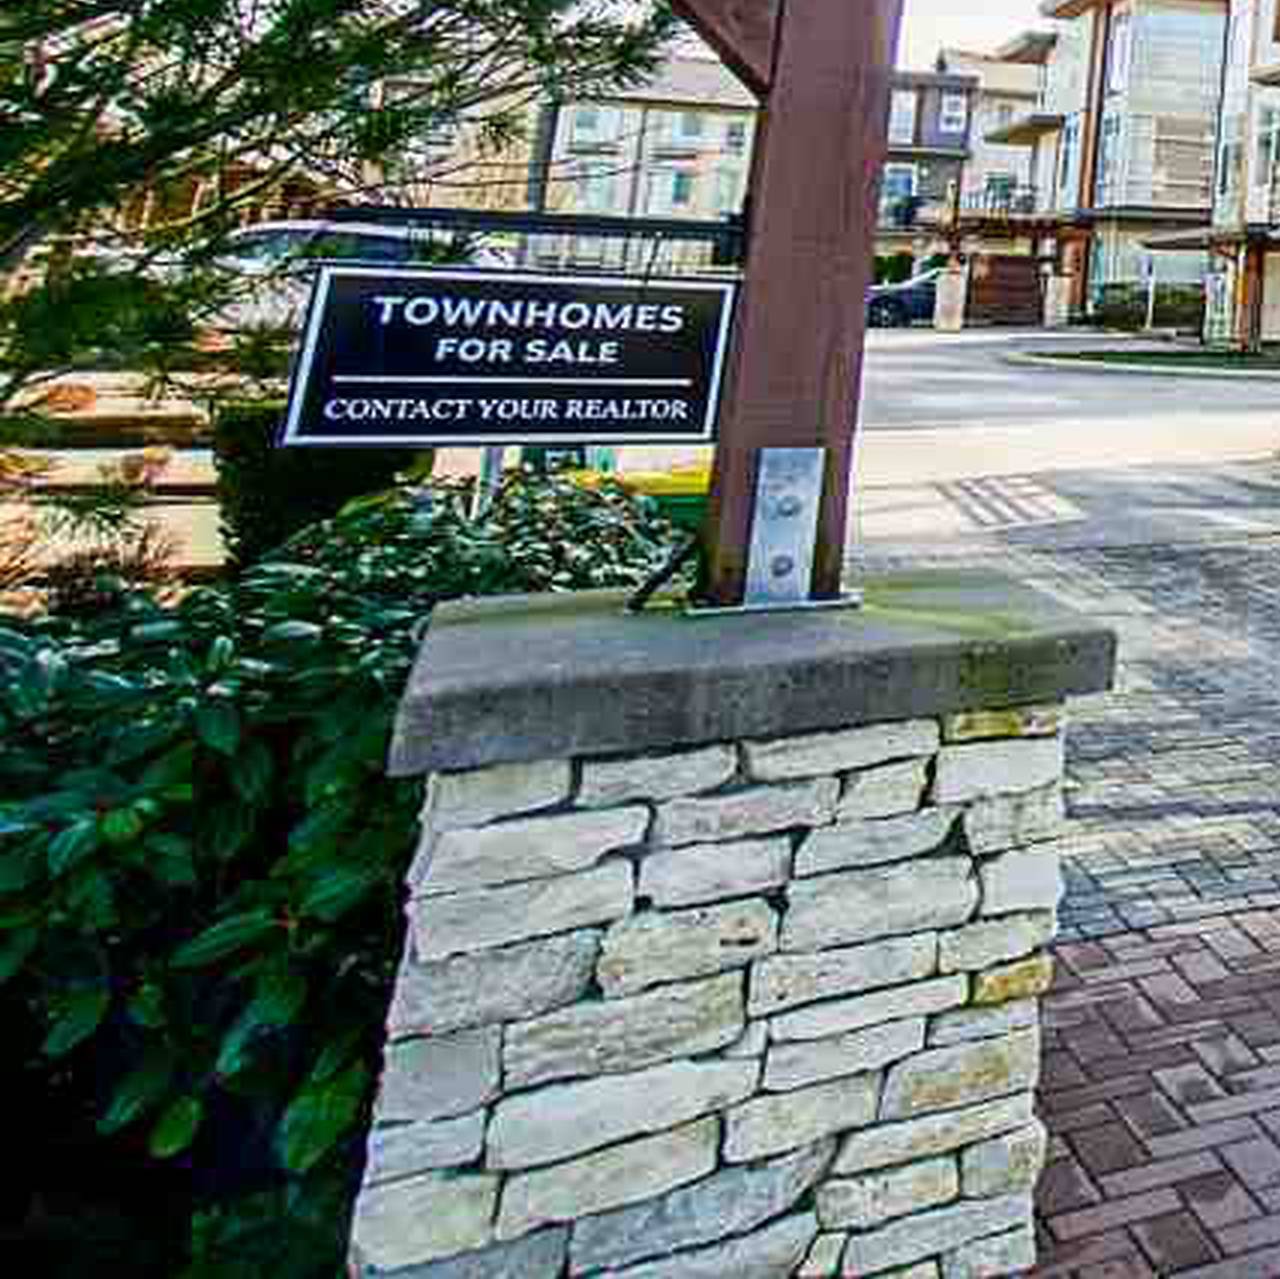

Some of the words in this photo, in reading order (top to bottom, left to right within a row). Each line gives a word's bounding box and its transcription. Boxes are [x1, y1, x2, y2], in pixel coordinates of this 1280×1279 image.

[372, 295, 685, 333] TOWNHOMES
[433, 338, 513, 363] FOR
[525, 340, 620, 365] SALE
[323, 397, 474, 421] CONTACT
[477, 397, 560, 421] YOUR
[563, 398, 689, 422] REALTOR
